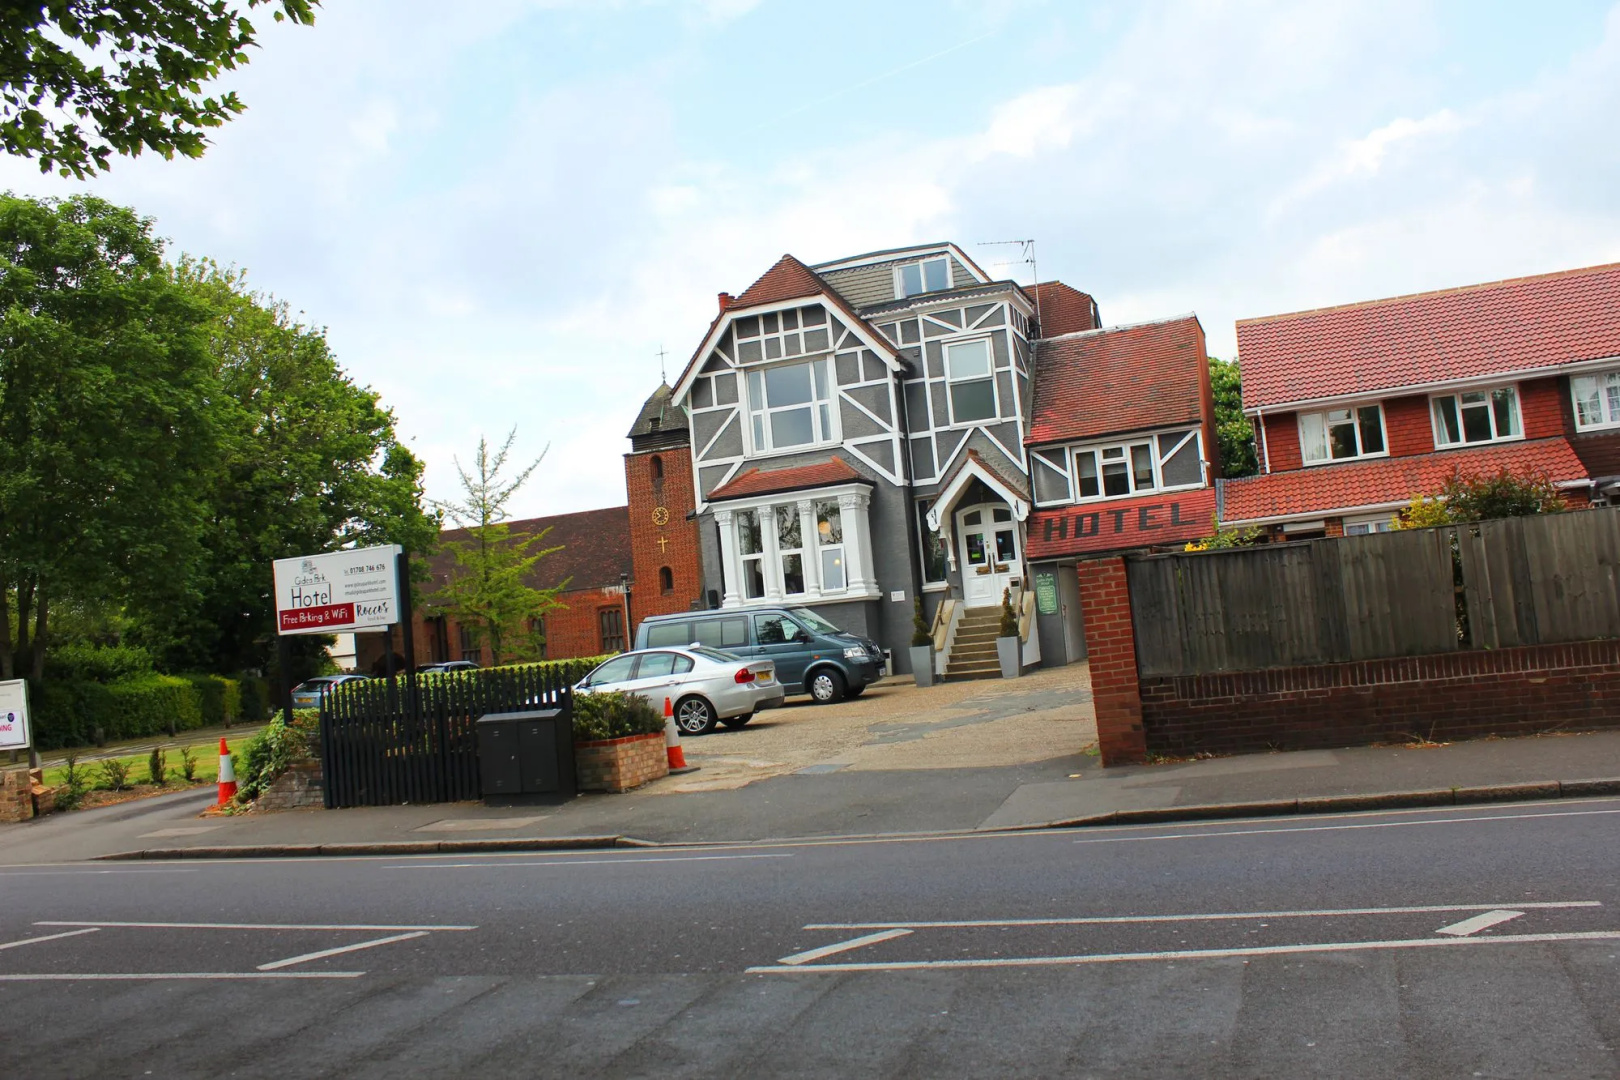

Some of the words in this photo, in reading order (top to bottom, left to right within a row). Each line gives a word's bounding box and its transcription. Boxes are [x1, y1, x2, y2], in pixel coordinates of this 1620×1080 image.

[1043, 502, 1196, 542] HOTEL
[313, 573, 326, 582] Park
[350, 566, 365, 574] 01708
[291, 583, 331, 608] Hotel
[283, 614, 298, 625] Free
[299, 611, 323, 623] Parking
[324, 610, 330, 620] &
[331, 607, 348, 619] WiFi
